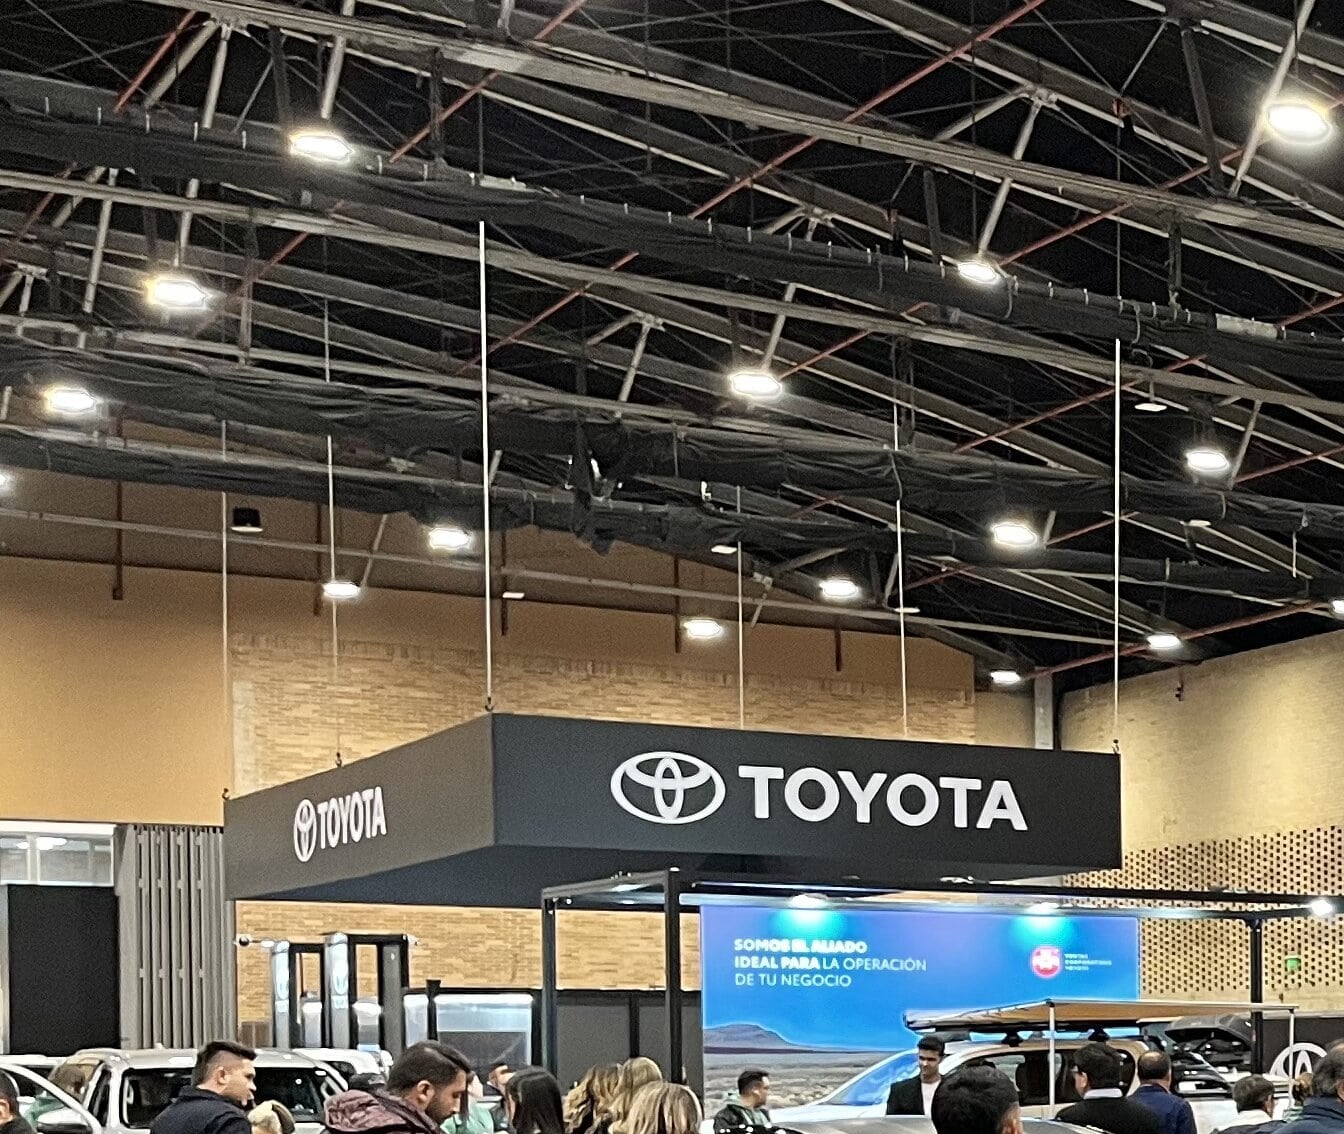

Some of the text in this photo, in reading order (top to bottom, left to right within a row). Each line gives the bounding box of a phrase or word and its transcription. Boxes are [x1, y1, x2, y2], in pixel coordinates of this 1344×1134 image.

[738, 765, 1028, 831] TOYOTA
[317, 786, 387, 850] TOYOTA
[734, 938, 867, 954] SOMOS EL ALIADO
[735, 956, 927, 971] IDEAL PARA LA OPERACIÓN
[735, 973, 852, 987] DE TU NEGOCIO
